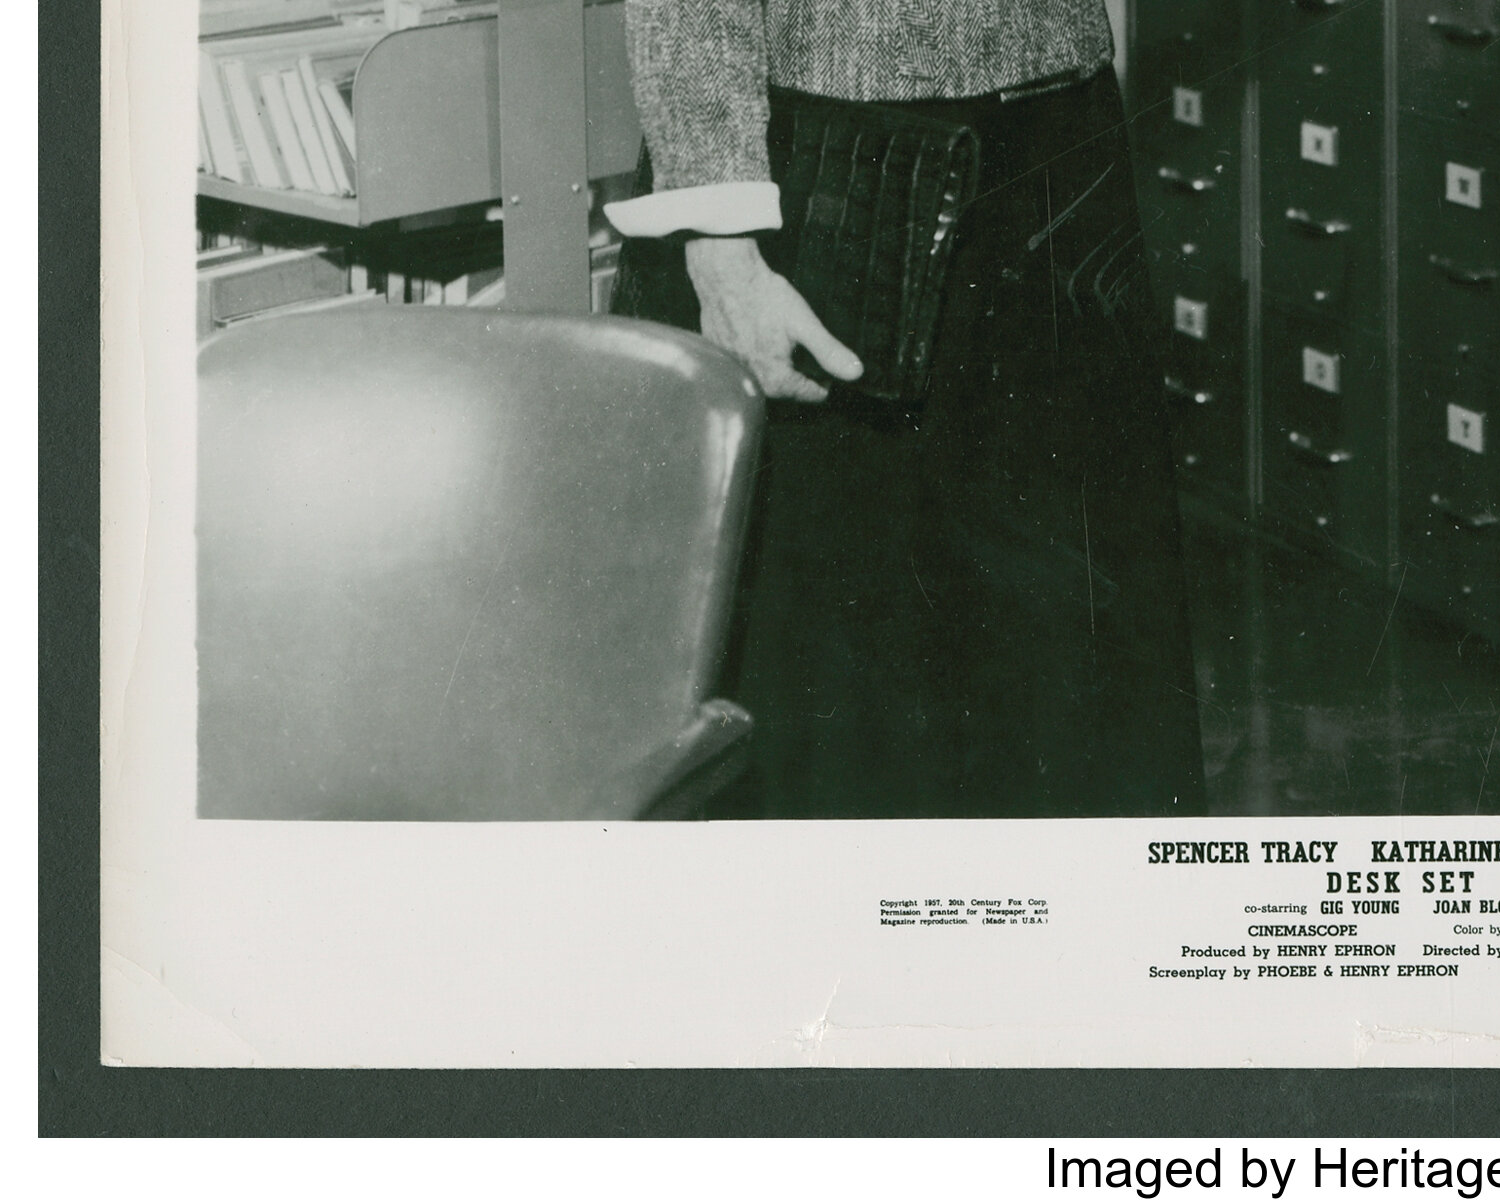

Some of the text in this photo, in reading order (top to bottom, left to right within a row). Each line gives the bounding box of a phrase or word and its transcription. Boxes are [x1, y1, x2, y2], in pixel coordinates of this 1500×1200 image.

[1148, 841, 1250, 865] SPENCER
[1260, 840, 1339, 864] TRACY
[1326, 870, 1475, 894] DESK SET
[880, 900, 917, 908] Copyright
[971, 899, 1002, 907] Century
[1244, 903, 1308, 916] co-starring
[1320, 900, 1344, 915] GIG
[1351, 899, 1400, 915] YOUNG
[1432, 899, 1472, 915] JOAN
[929, 909, 958, 917] granted
[986, 908, 1026, 916] Newspaper
[880, 918, 916, 927] Magazine
[1247, 924, 1358, 938] CINEMASCOPE
[1453, 924, 1484, 935] Color
[1181, 945, 1247, 958] Produced
[1252, 945, 1271, 960] by
[1276, 944, 1328, 957] HENRY
[1334, 944, 1397, 957] EPHRON
[1422, 944, 1481, 956] Directed
[1149, 965, 1227, 981] Screenplay
[1233, 965, 1251, 981] by
[1257, 965, 1317, 978] PHOEBE
[1323, 965, 1334, 977] &
[1339, 964, 1391, 977] HENRY
[1396, 964, 1459, 977] EPHRON
